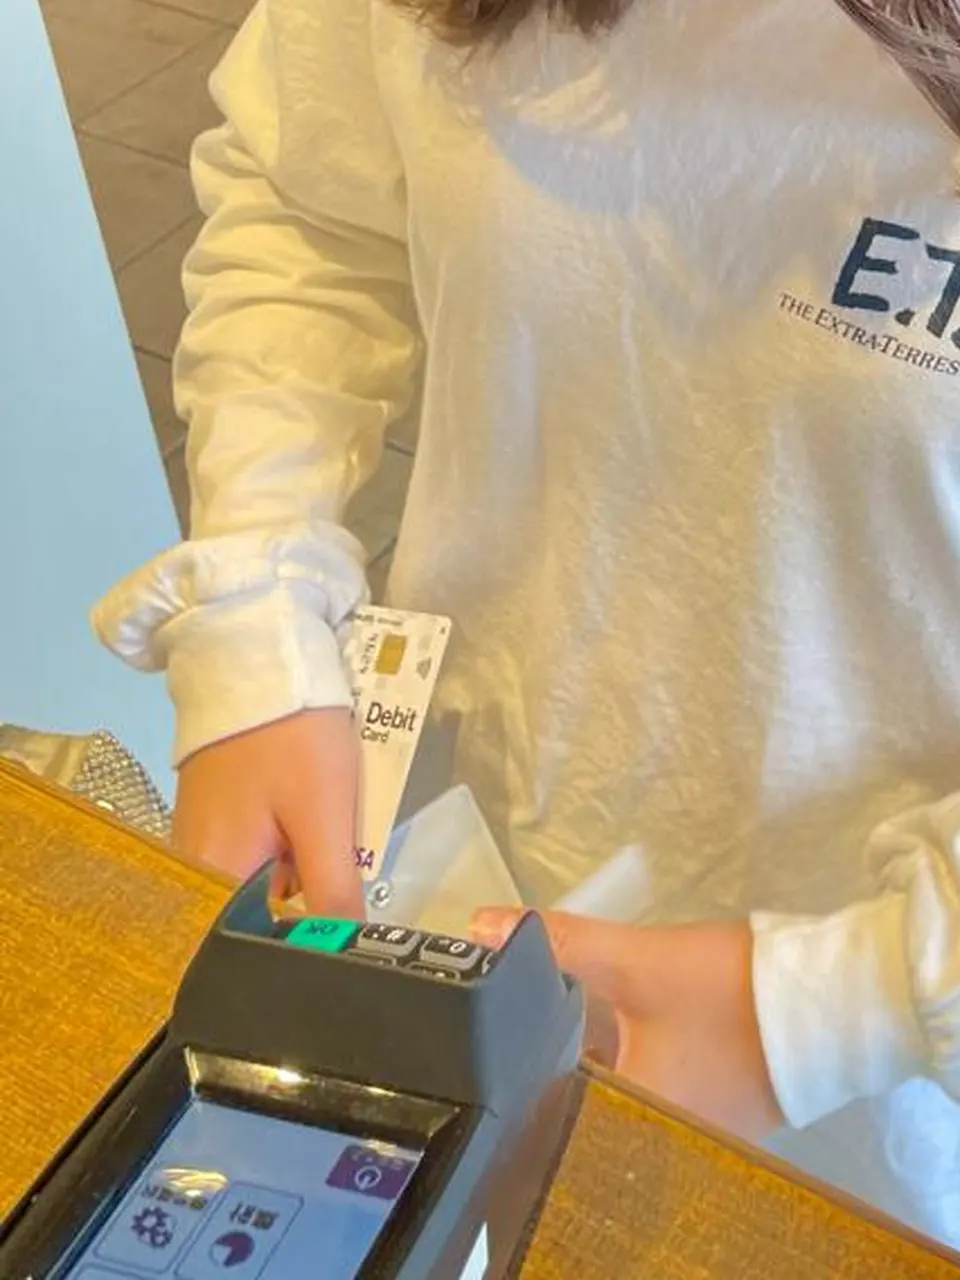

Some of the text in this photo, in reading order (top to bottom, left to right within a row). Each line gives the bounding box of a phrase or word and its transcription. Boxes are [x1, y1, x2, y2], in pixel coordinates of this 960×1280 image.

[778, 291, 815, 321] THE
[366, 701, 418, 732] Debit
[360, 725, 390, 743] Card
